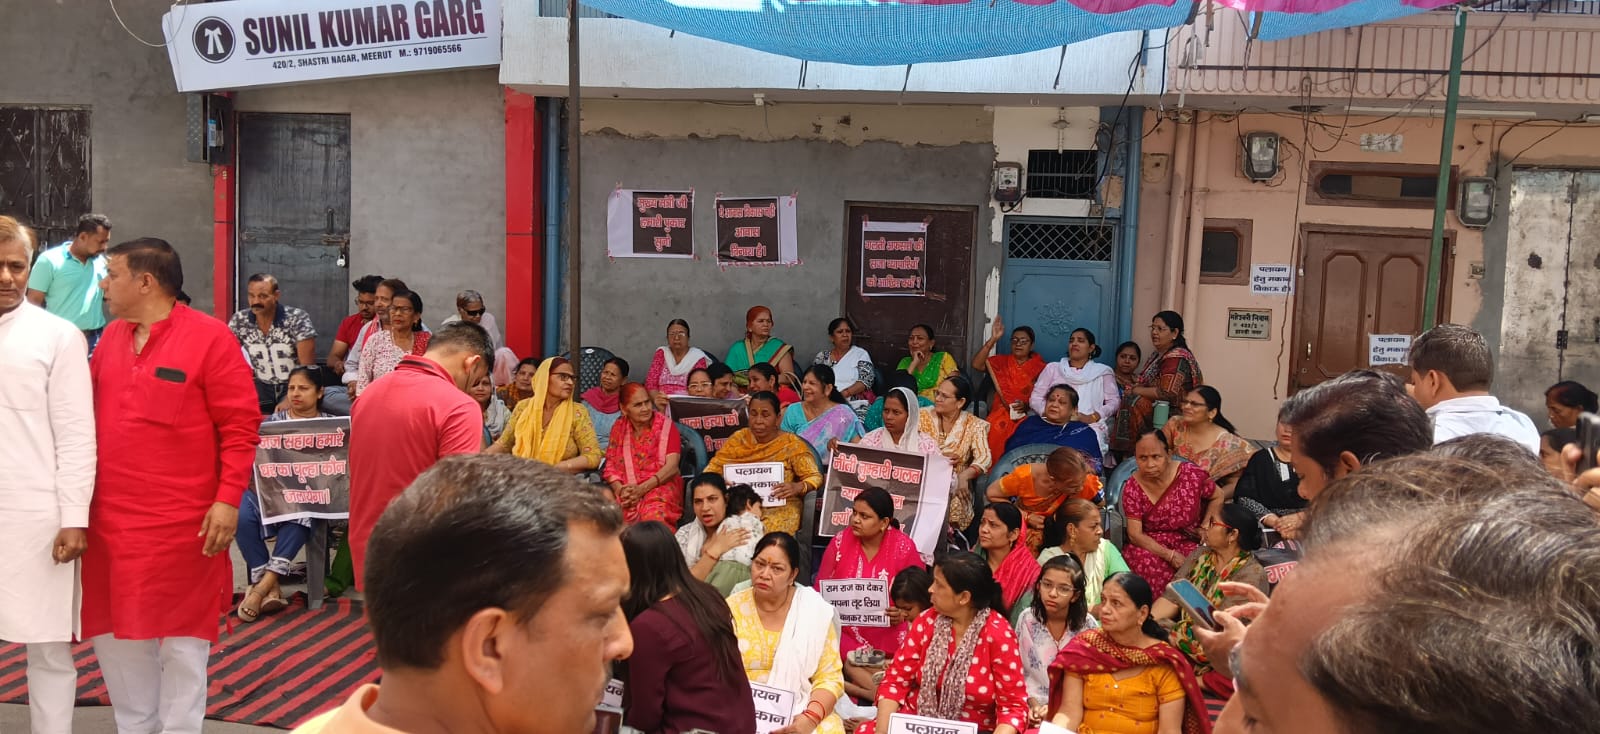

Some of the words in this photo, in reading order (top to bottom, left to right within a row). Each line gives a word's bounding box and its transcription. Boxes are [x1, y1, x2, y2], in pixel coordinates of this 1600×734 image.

[243, 13, 316, 55] SUNIL
[318, 5, 410, 49] KUMAR
[414, 0, 485, 39] GARG
[298, 57, 329, 68] SHASTRI
[331, 54, 359, 65] NAGAR,
[361, 50, 392, 61] MEERUT
[637, 197, 657, 213] मुख्य
[676, 194, 688, 208] जी
[640, 213, 662, 228] हमारी
[664, 218, 686, 232] पुकार
[734, 226, 761, 237] आवास
[654, 233, 672, 252] सुनो
[864, 237, 886, 251] गलती
[914, 237, 925, 252] की
[866, 274, 877, 288] को
[1253, 275, 1266, 284] हेतु
[249, 342, 298, 384] 36
[702, 414, 725, 430] हत्या
[725, 408, 739, 426] को
[315, 427, 345, 449] हमारे
[259, 463, 277, 478] घर
[277, 463, 292, 477] का
[292, 462, 320, 484] चूल्हा
[320, 455, 346, 475] कौन
[735, 466, 772, 476] पलायन
[833, 452, 858, 473] नीती
[858, 459, 892, 482] तुम्हारी
[892, 466, 922, 484] गलत
[826, 584, 839, 593] राम
[840, 584, 853, 592] राज
[855, 584, 865, 592] का
[867, 582, 884, 593] देकर
[852, 599, 863, 610] लूट
[864, 596, 881, 608] लिया
